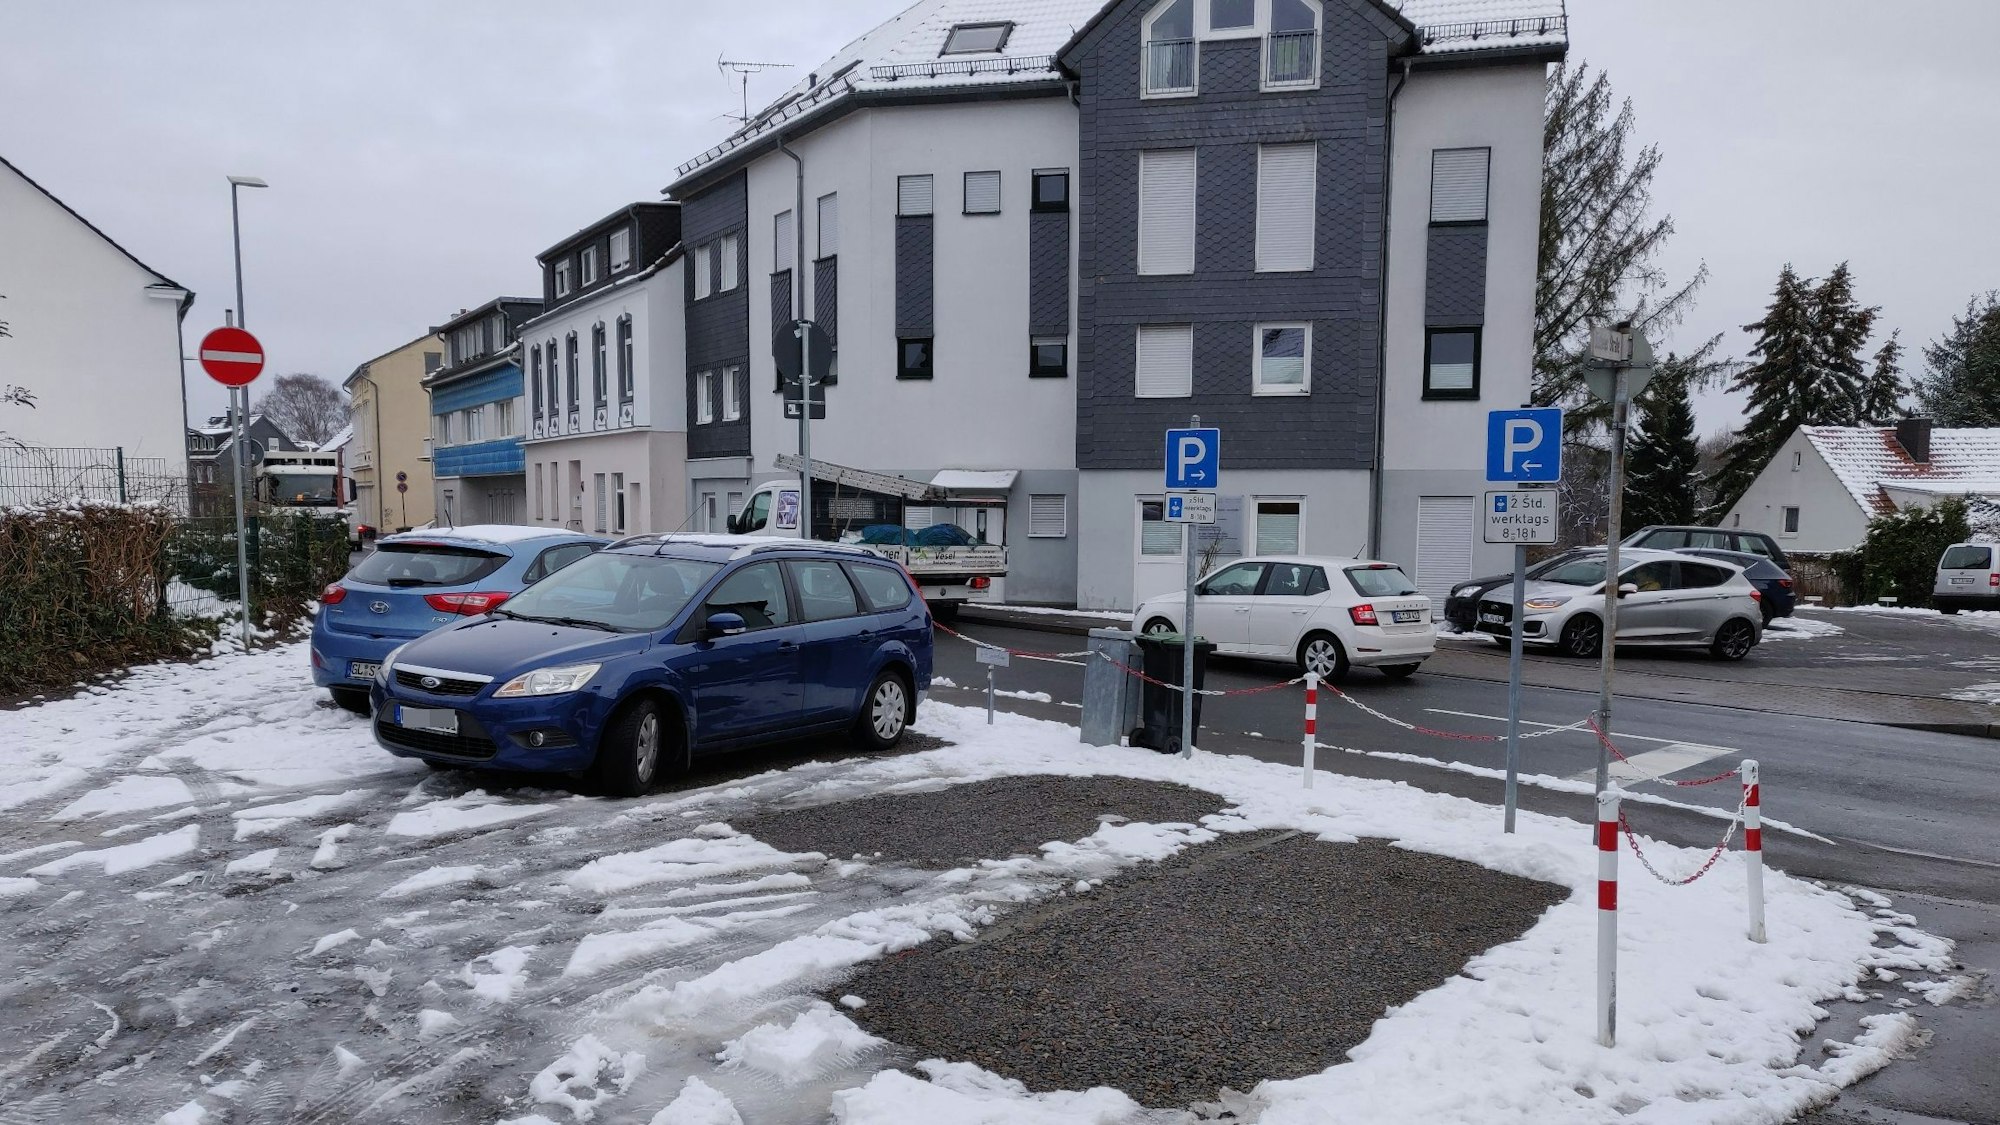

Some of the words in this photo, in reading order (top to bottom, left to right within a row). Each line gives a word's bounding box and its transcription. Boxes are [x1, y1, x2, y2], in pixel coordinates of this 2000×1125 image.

[1504, 419, 1544, 473] P
[1178, 437, 1206, 481] P
[1511, 498, 1518, 509] 2
[1522, 497, 1546, 509] Std.
[1491, 513, 1550, 526] werktags
[935, 551, 956, 560] Vesel
[352, 663, 363, 675] GL
